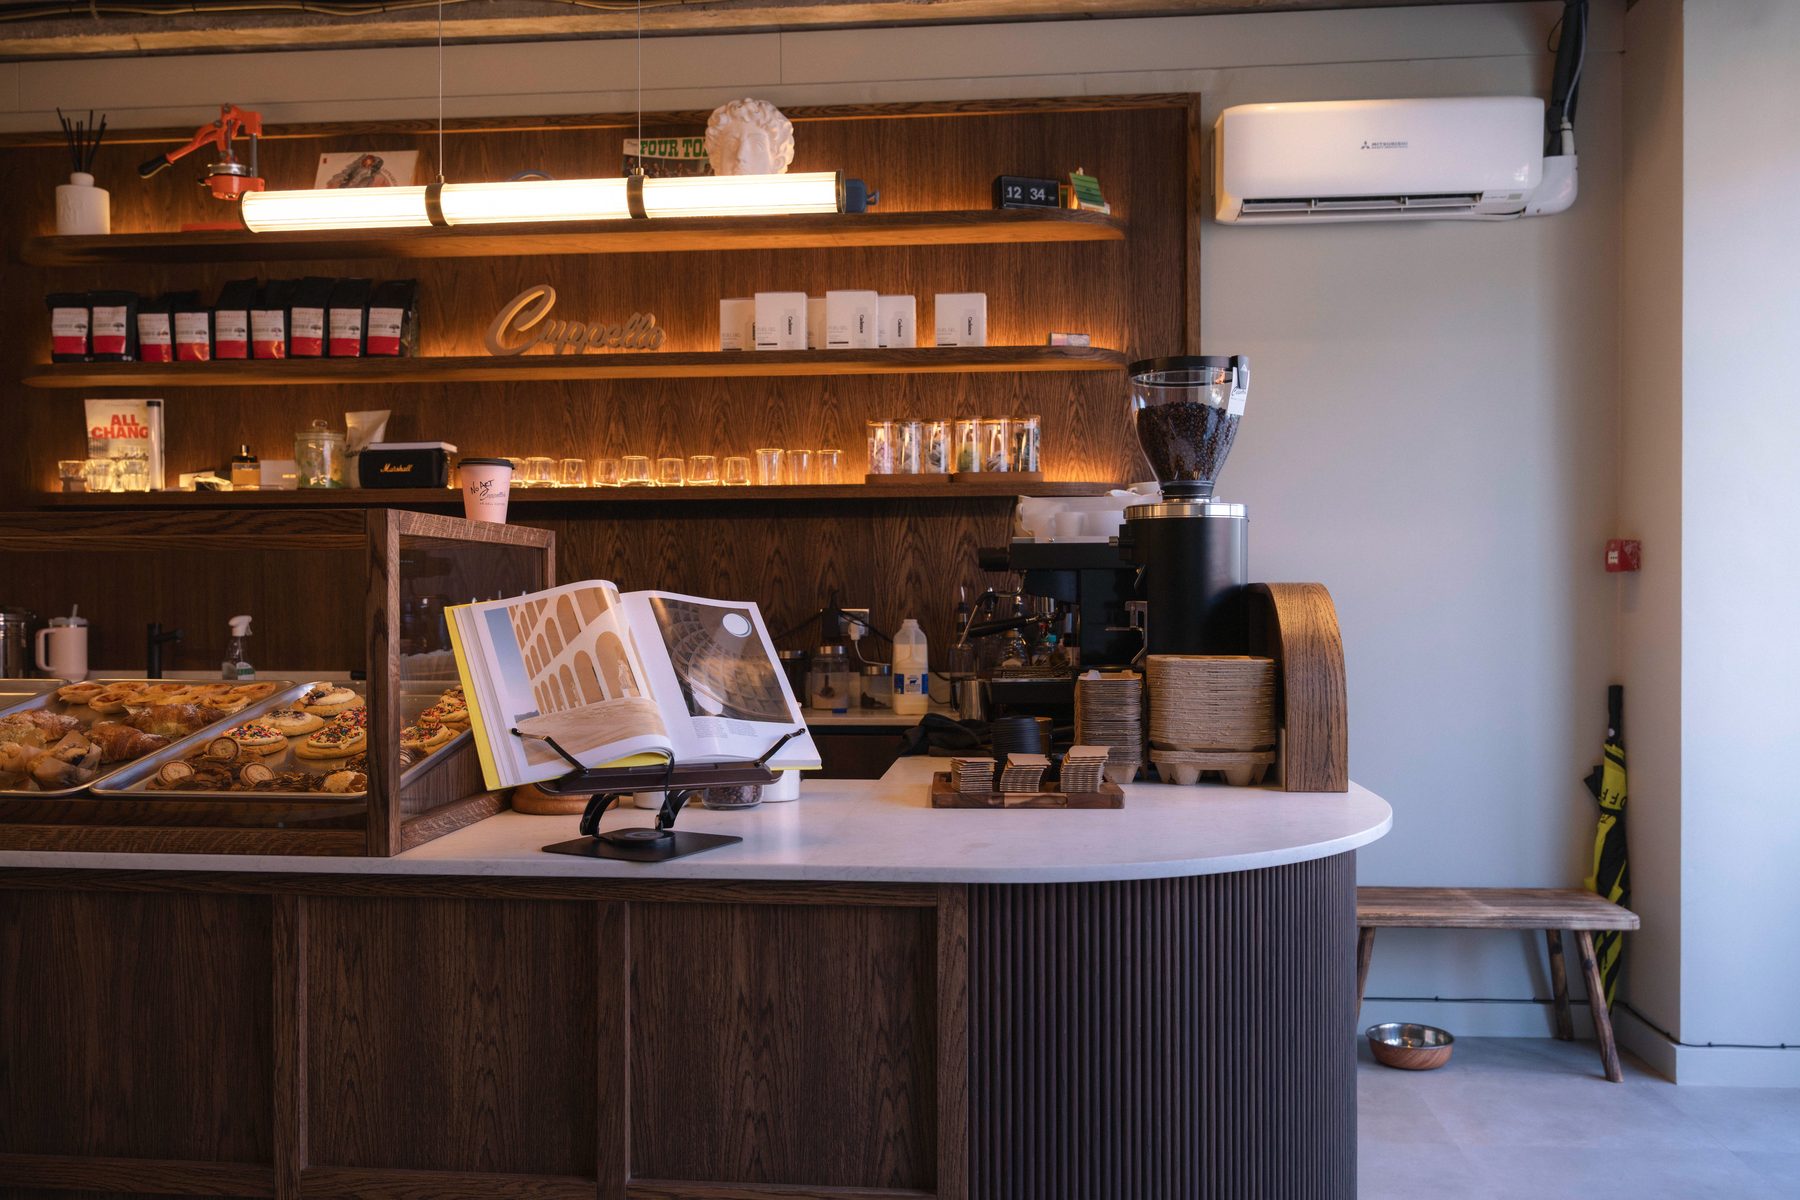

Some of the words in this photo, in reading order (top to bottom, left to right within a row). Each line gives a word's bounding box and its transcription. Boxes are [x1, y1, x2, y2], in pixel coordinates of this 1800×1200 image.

[640, 139, 679, 157] FOUR
[1006, 186, 1021, 198] 12
[1030, 188, 1045, 201] 34
[111, 414, 140, 426] ALL
[91, 426, 148, 439] CHANG
[380, 463, 413, 473] Marshall
